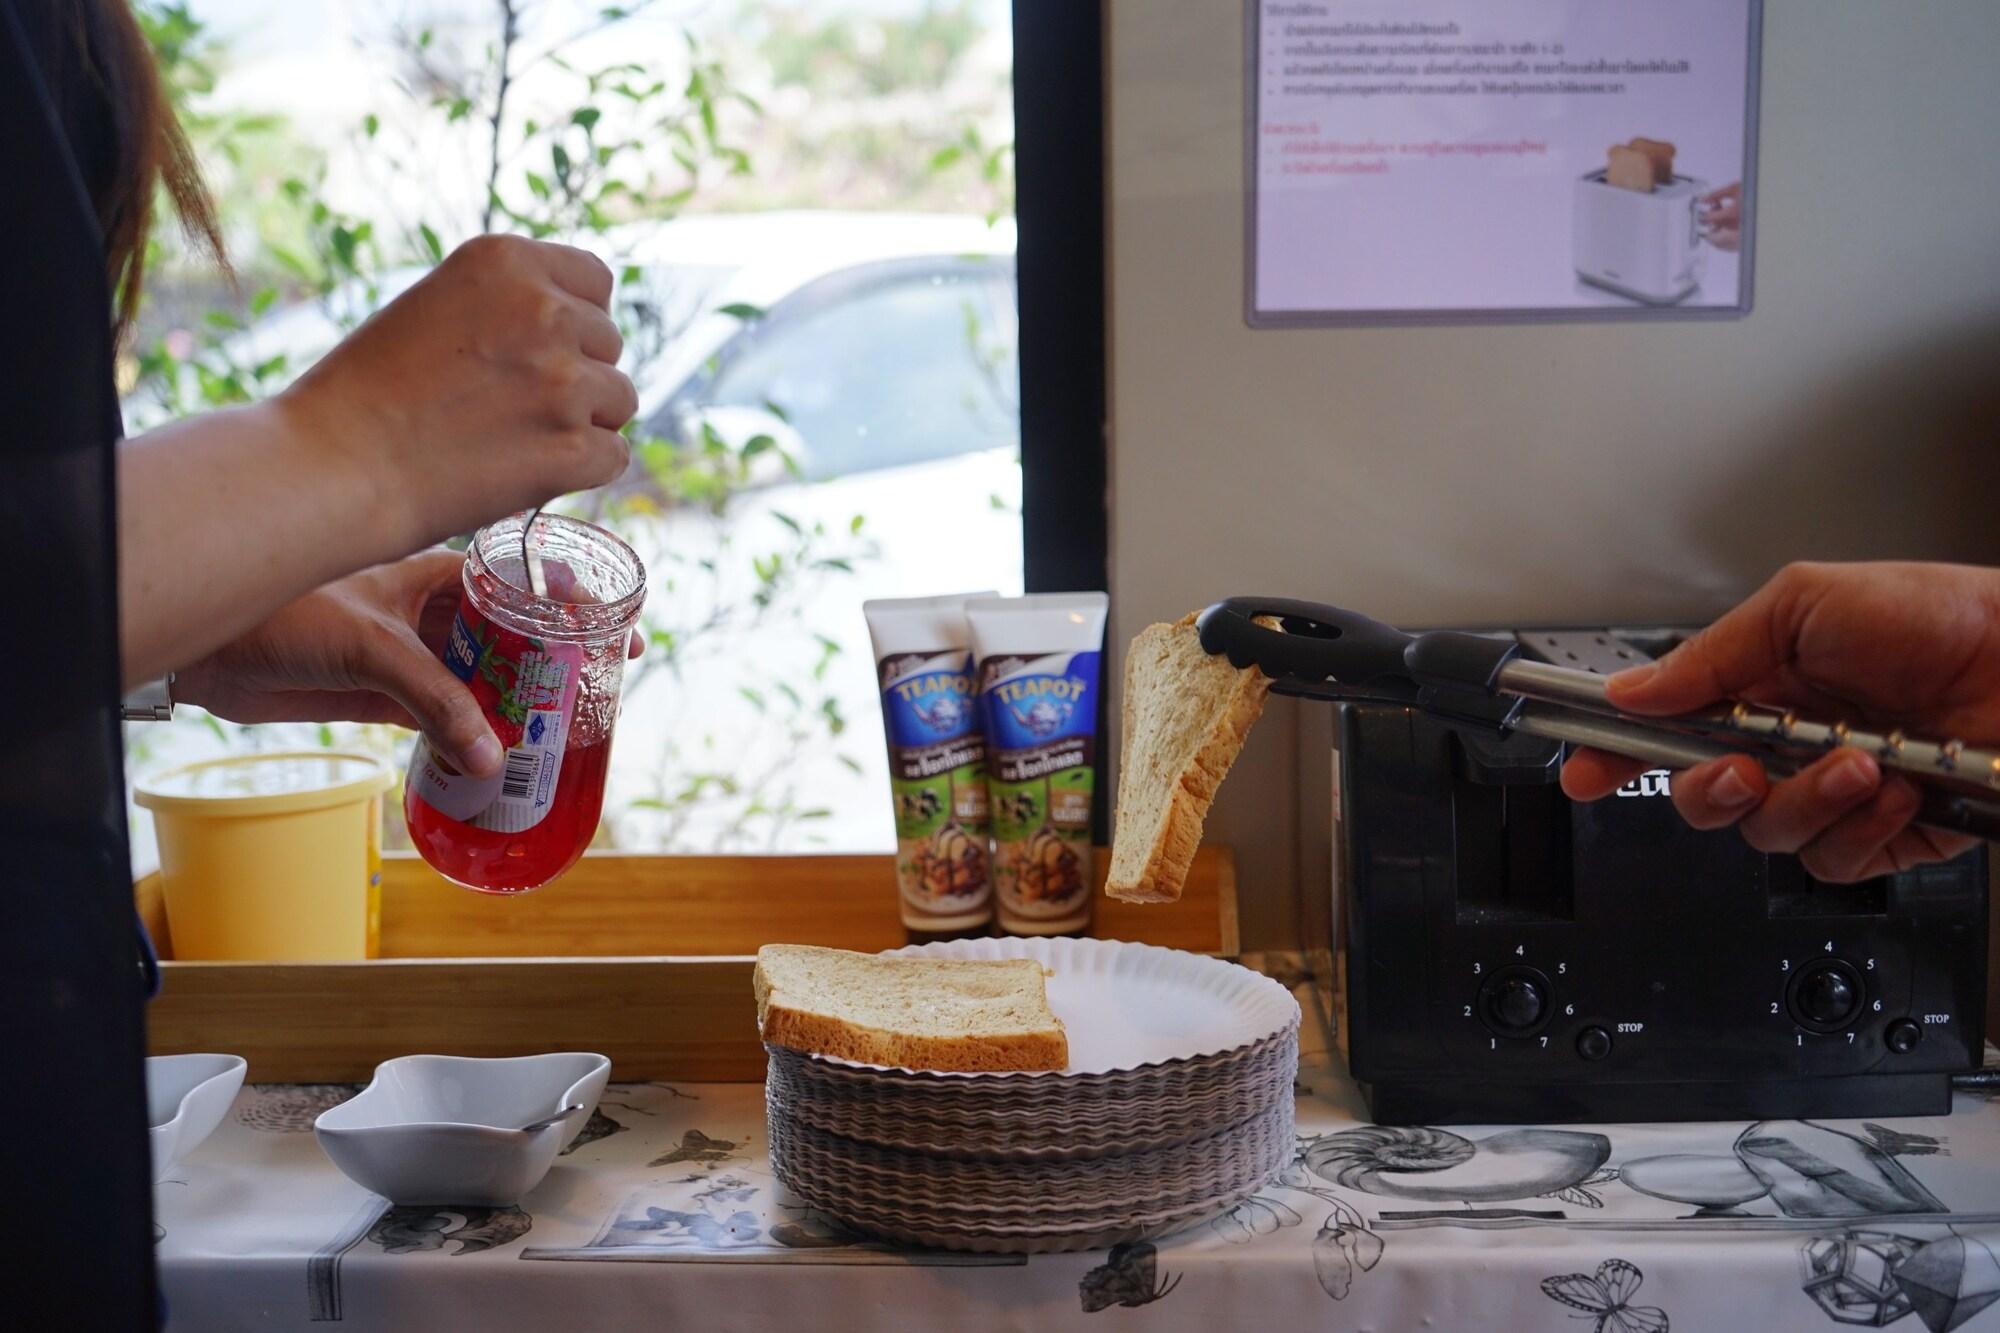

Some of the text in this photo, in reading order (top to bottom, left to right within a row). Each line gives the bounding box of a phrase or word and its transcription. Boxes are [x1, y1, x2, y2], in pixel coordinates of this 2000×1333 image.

[995, 677, 1086, 704] TEAPOT
[1515, 946, 1524, 955] 4
[1824, 942, 1833, 951] 4
[1473, 963, 1481, 973] 3
[1558, 963, 1566, 973] 5
[1781, 960, 1789, 970] 3
[1866, 959, 1875, 969] 5
[1565, 1005, 1574, 1014] 6
[1770, 1003, 1779, 1013] 2
[1872, 1000, 1881, 1011] 6
[1463, 1006, 1472, 1016] 2
[1925, 1015, 1949, 1023] STOP
[1618, 1023, 1643, 1032] STOP
[1540, 1037, 1548, 1047] 7
[1797, 1035, 1802, 1045] 1
[1847, 1033, 1855, 1043] 7
[1491, 1039, 1496, 1048] 1
